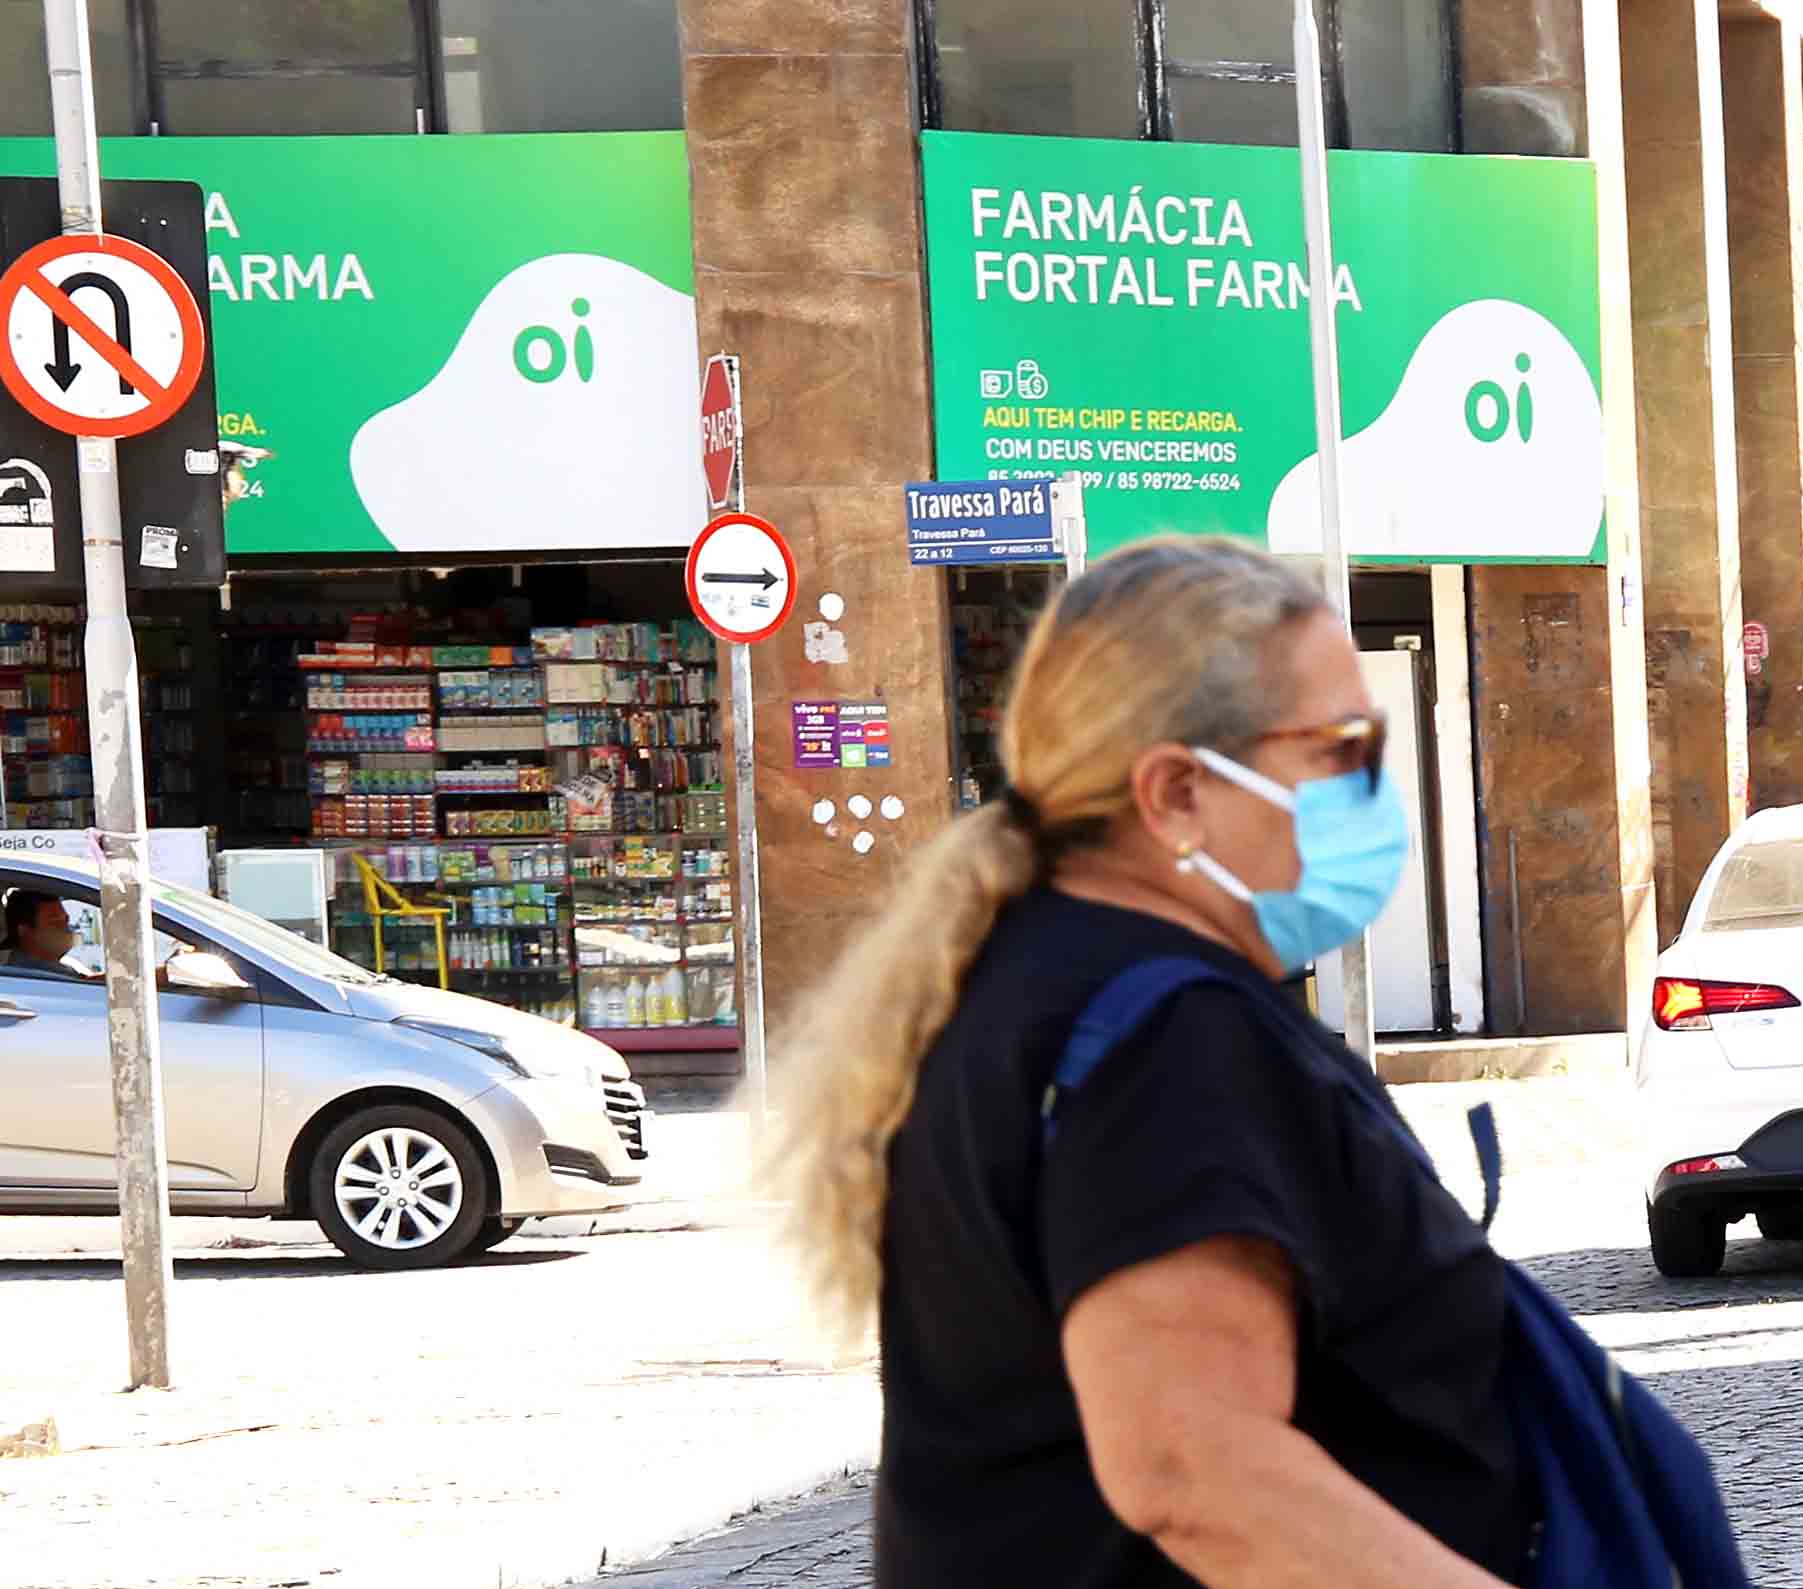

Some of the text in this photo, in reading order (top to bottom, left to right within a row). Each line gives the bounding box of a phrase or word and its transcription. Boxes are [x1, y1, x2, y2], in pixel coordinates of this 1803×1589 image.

[971, 185, 1253, 247] FARMÁCIA
[208, 253, 374, 301] ARMA
[975, 250, 1174, 306] FORTAL
[512, 296, 596, 385] oi
[1463, 350, 1534, 445] oi
[983, 406, 1244, 432] AQUI TEM CHIP E RECARGA.
[986, 437, 1237, 463] COM DEUS VENCEREMOS
[908, 484, 1045, 519] Travessa Pará
[1117, 472, 1138, 489] 85
[1142, 472, 1240, 491] 98722-6524
[914, 549, 928, 559] 22
[939, 548, 953, 559] 12
